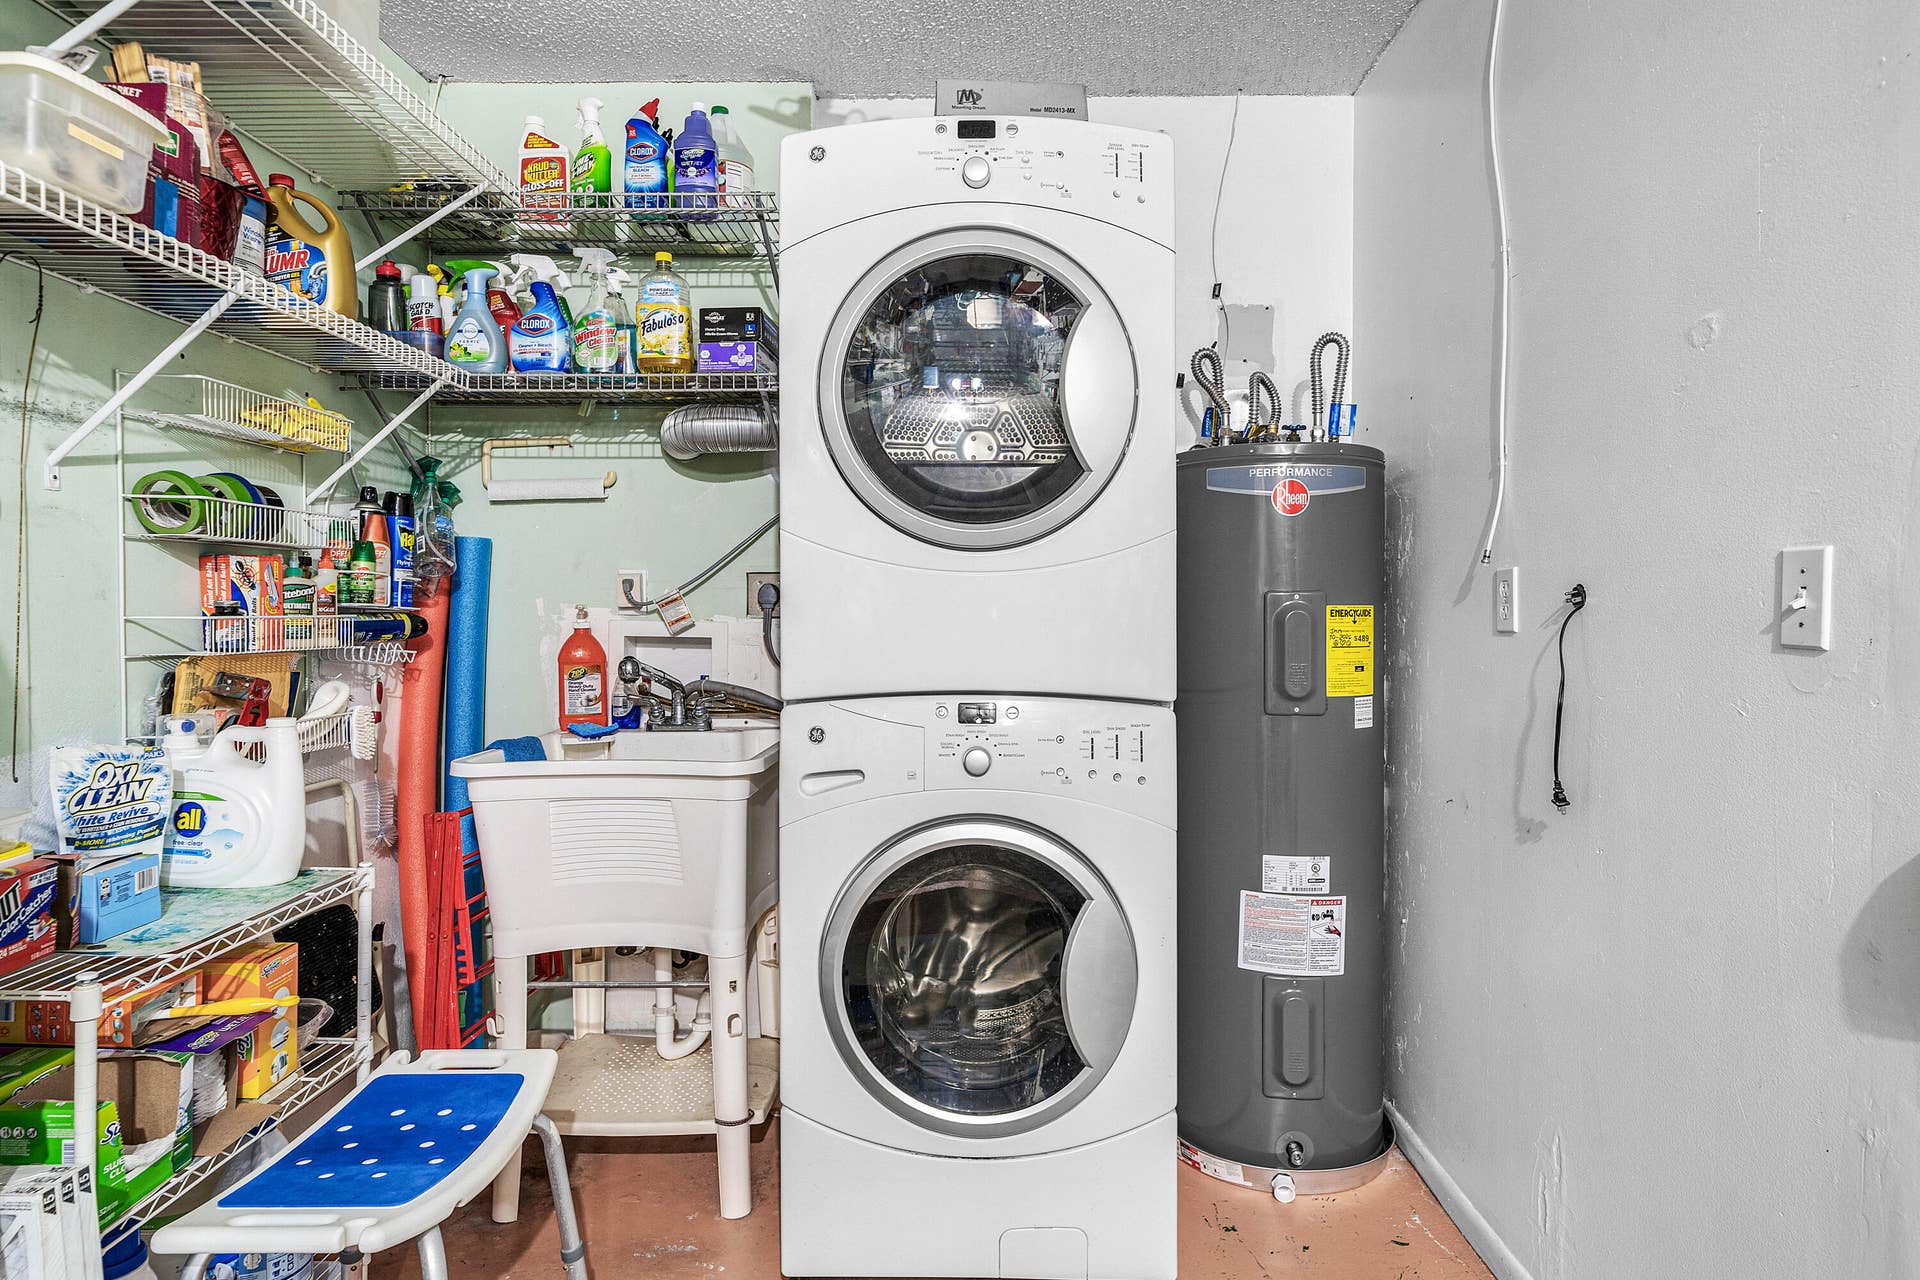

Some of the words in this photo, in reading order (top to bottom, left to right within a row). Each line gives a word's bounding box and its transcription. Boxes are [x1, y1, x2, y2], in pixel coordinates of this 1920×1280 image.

[526, 170, 558, 183] KUTTER
[527, 161, 550, 172] KRUD
[521, 319, 550, 329] CLOROX
[640, 314, 684, 336] Fabuloso
[575, 327, 616, 345] Window
[1250, 468, 1333, 477] PERFORMANCE
[1276, 480, 1307, 510] Rheem
[91, 762, 139, 790] OXI
[68, 777, 153, 815] CLEAN
[108, 806, 149, 824] Revive
[177, 808, 202, 830] all
[20, 884, 56, 919] Catcher
